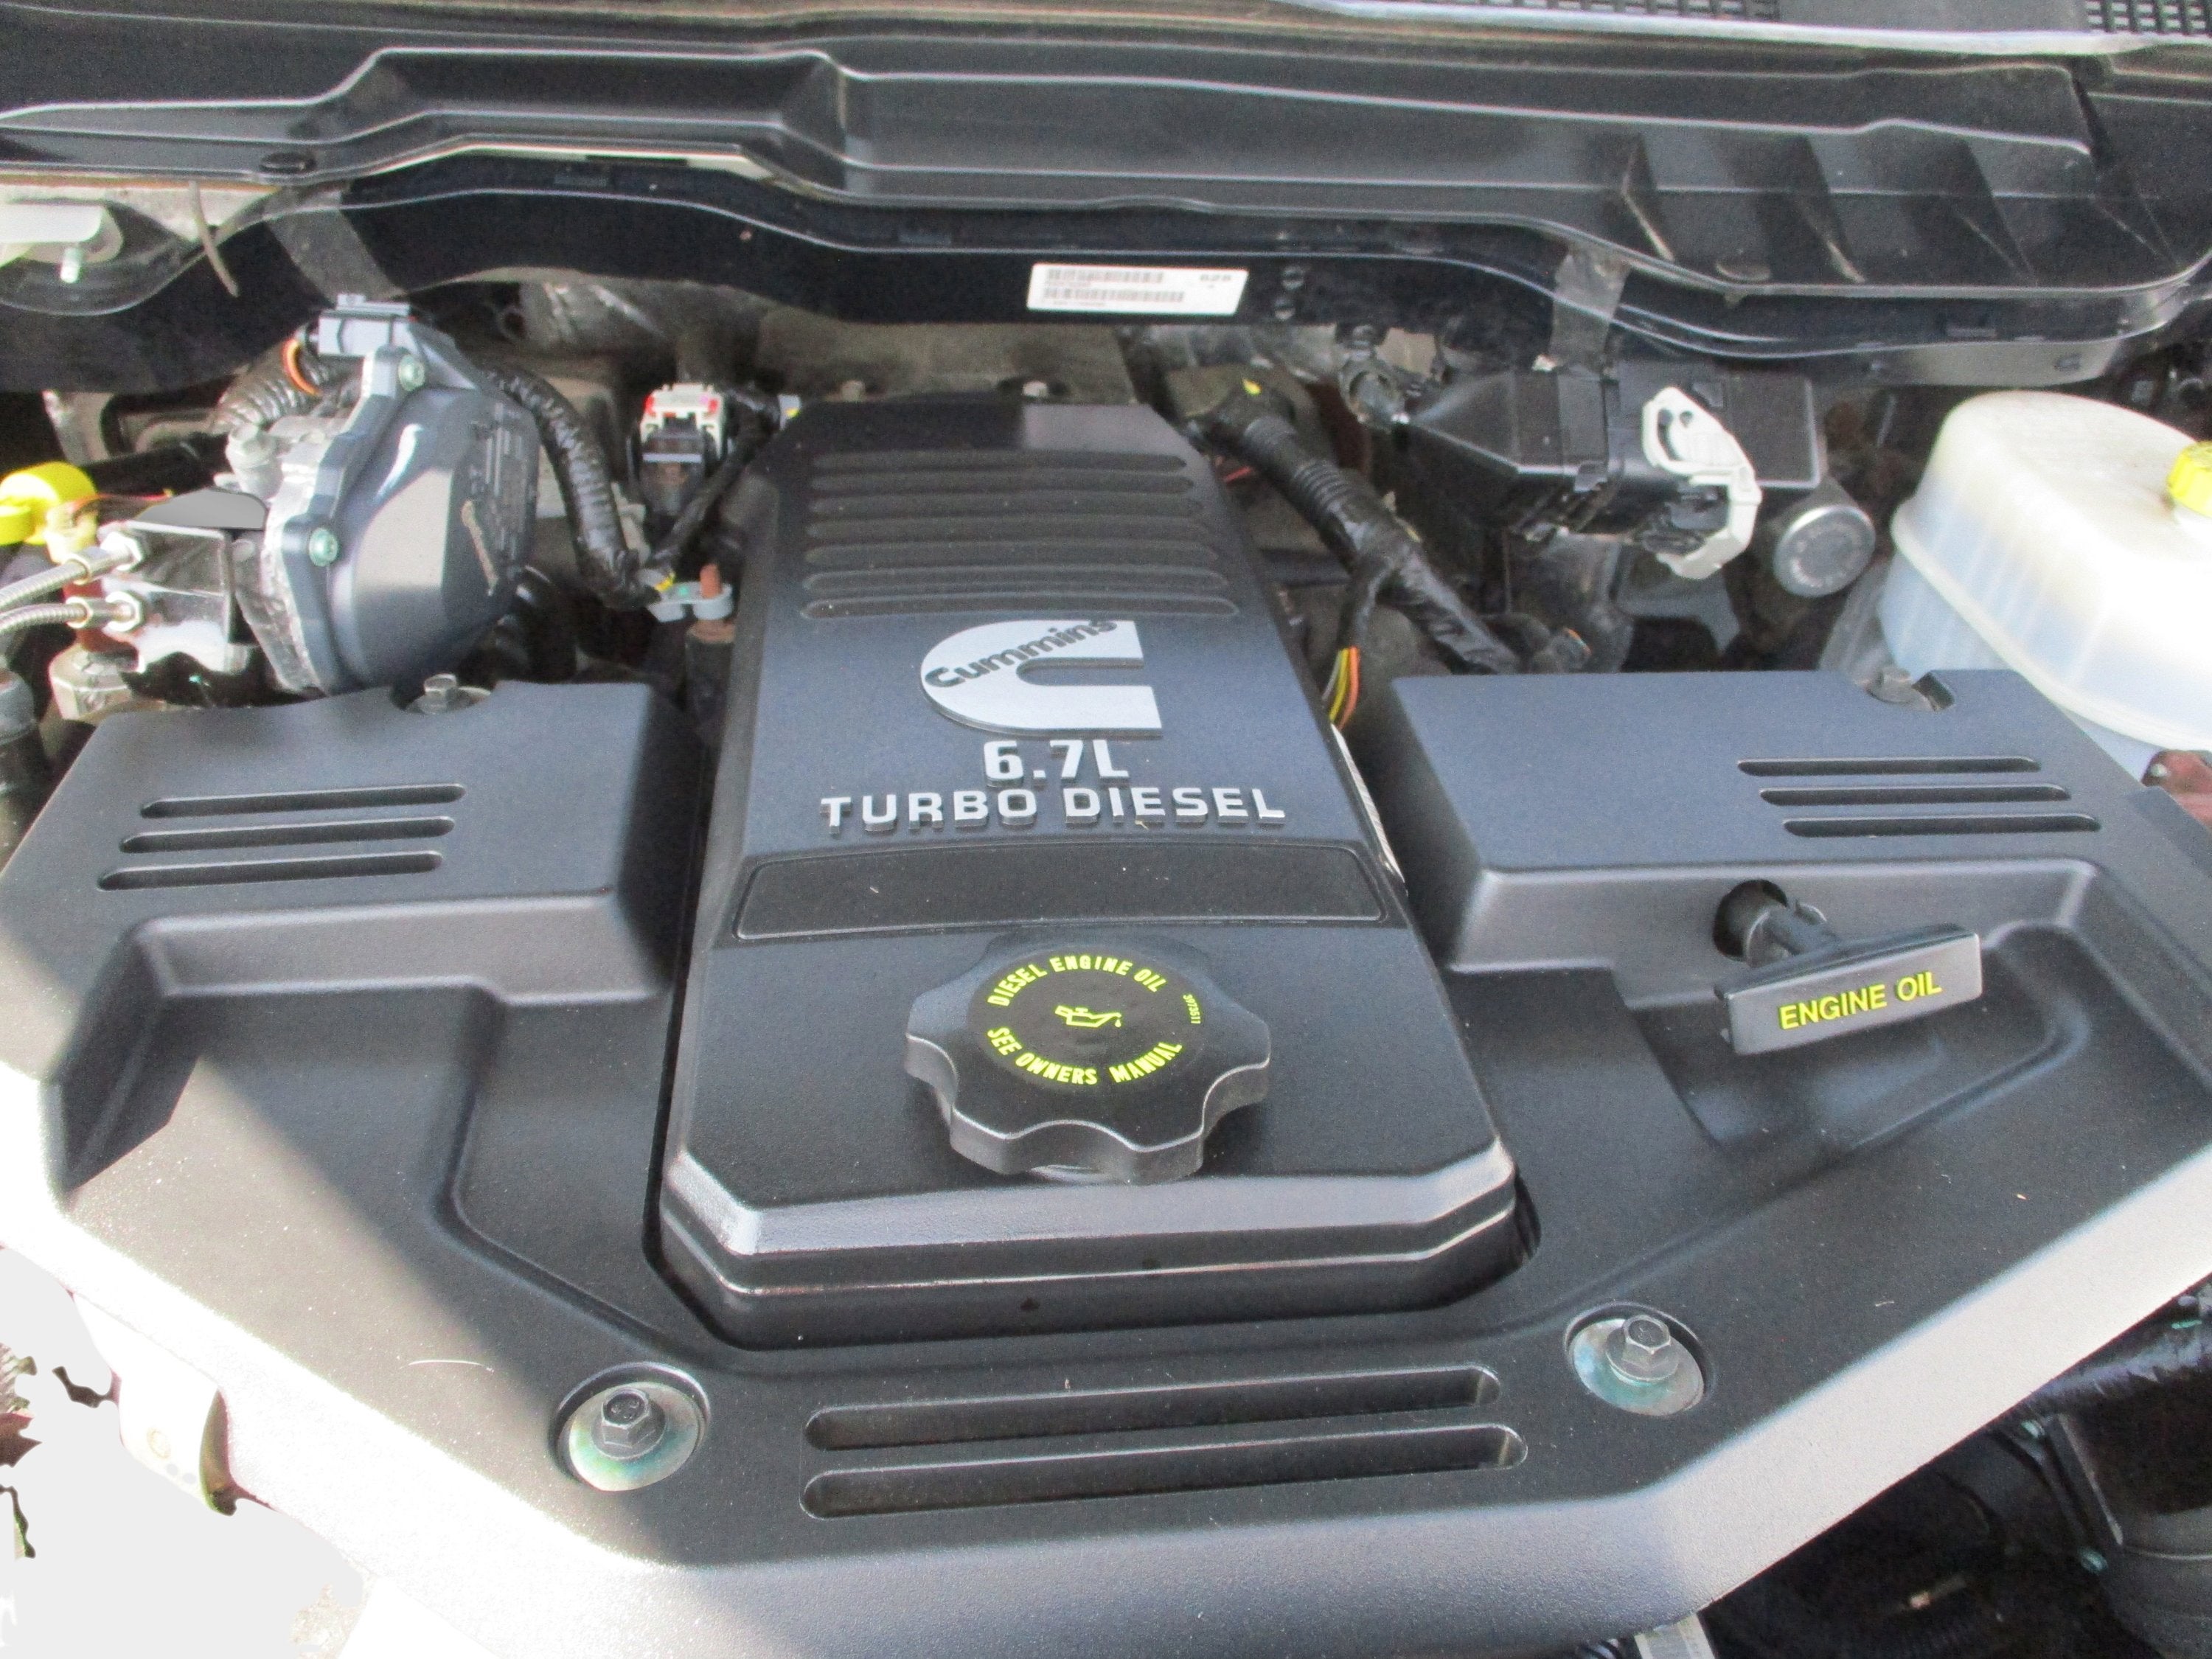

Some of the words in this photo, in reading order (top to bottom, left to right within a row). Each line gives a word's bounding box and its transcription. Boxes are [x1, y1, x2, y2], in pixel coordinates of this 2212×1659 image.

[924, 617, 1119, 688] Cummins
[983, 739, 1130, 786] 6.7L
[821, 788, 1037, 833] TURBO
[1062, 787, 1287, 825] DIESEL
[987, 964, 1048, 1006] DIESEL
[1049, 955, 1133, 975] ENGINE
[1133, 968, 1167, 992] OIL
[1778, 983, 1888, 1030] ENGINE
[1896, 971, 1942, 1002] OIL
[987, 1026, 1023, 1056] SEE
[1015, 1051, 1098, 1085] OWNERS
[1108, 1041, 1183, 1083] MANUAL
